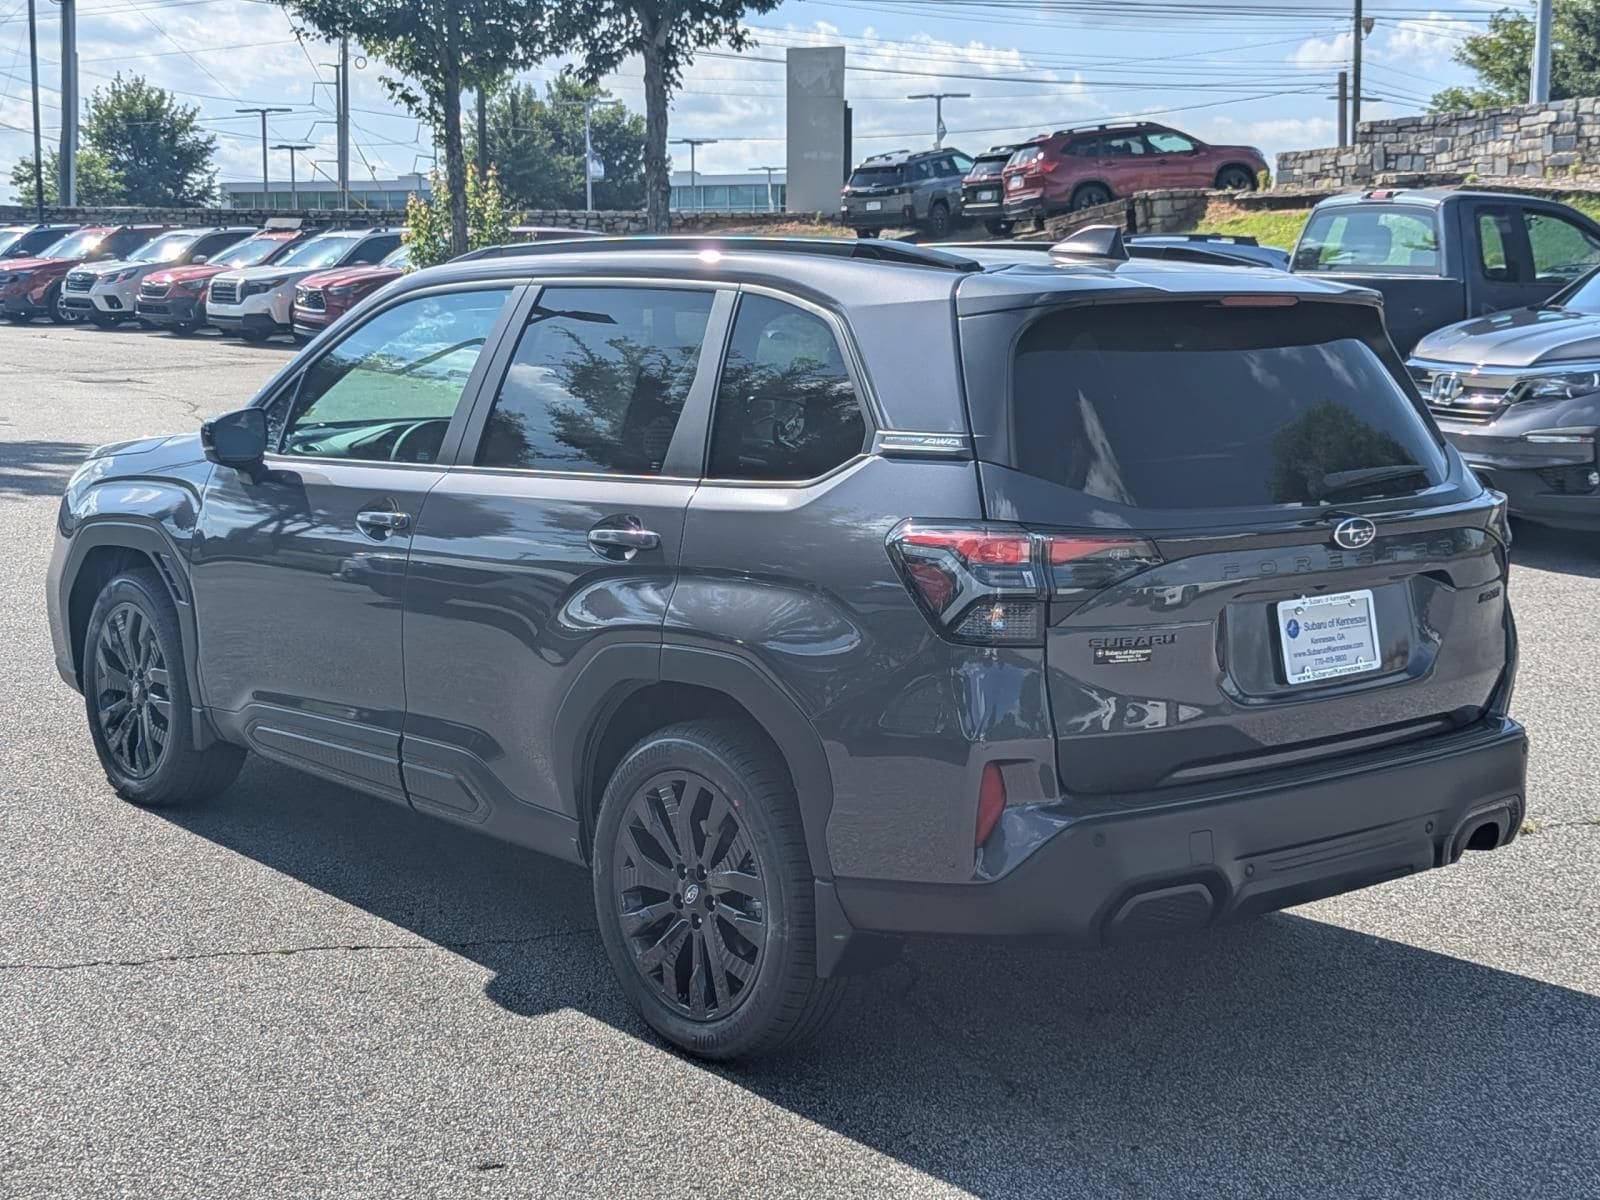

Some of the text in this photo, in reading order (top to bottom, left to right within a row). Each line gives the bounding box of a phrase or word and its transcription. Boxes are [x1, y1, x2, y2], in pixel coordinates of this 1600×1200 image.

[921, 437, 960, 447] AWD
[1222, 539, 1452, 579] FORESTER
[1303, 615, 1367, 632] Subaru of Kennesaw
[1087, 633, 1177, 648] SUBARU
[1337, 633, 1345, 641] GA
